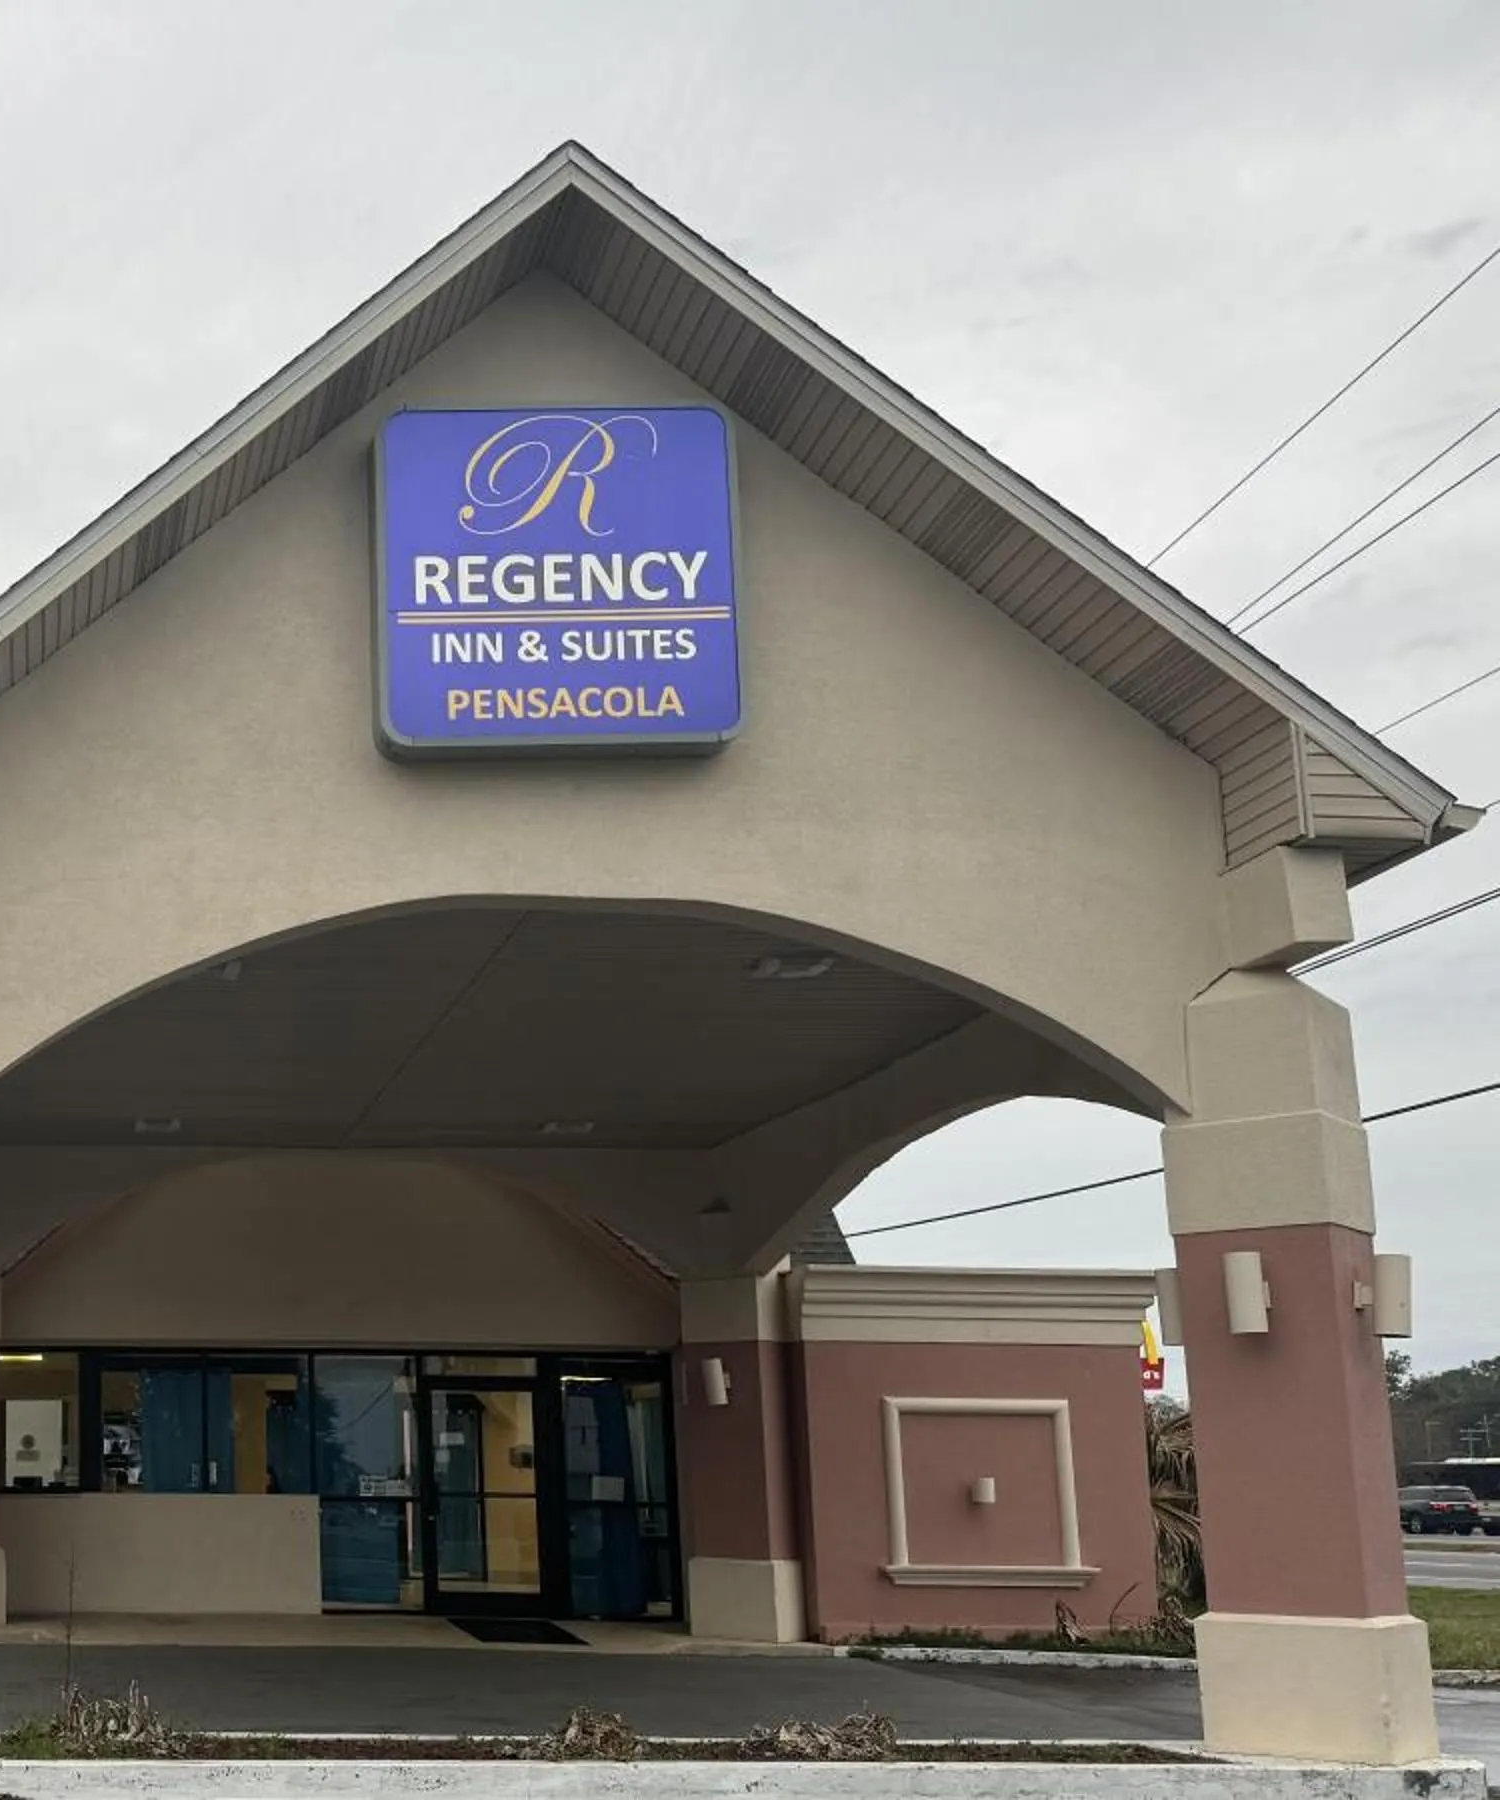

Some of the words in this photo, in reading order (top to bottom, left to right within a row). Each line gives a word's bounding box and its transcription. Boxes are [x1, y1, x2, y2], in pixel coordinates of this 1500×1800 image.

[459, 415, 657, 536] R
[414, 551, 708, 605] REGENCY
[431, 632, 503, 664] INN
[517, 631, 549, 663] &
[561, 629, 697, 662] SUITES
[447, 686, 685, 720] PENSACOLA
